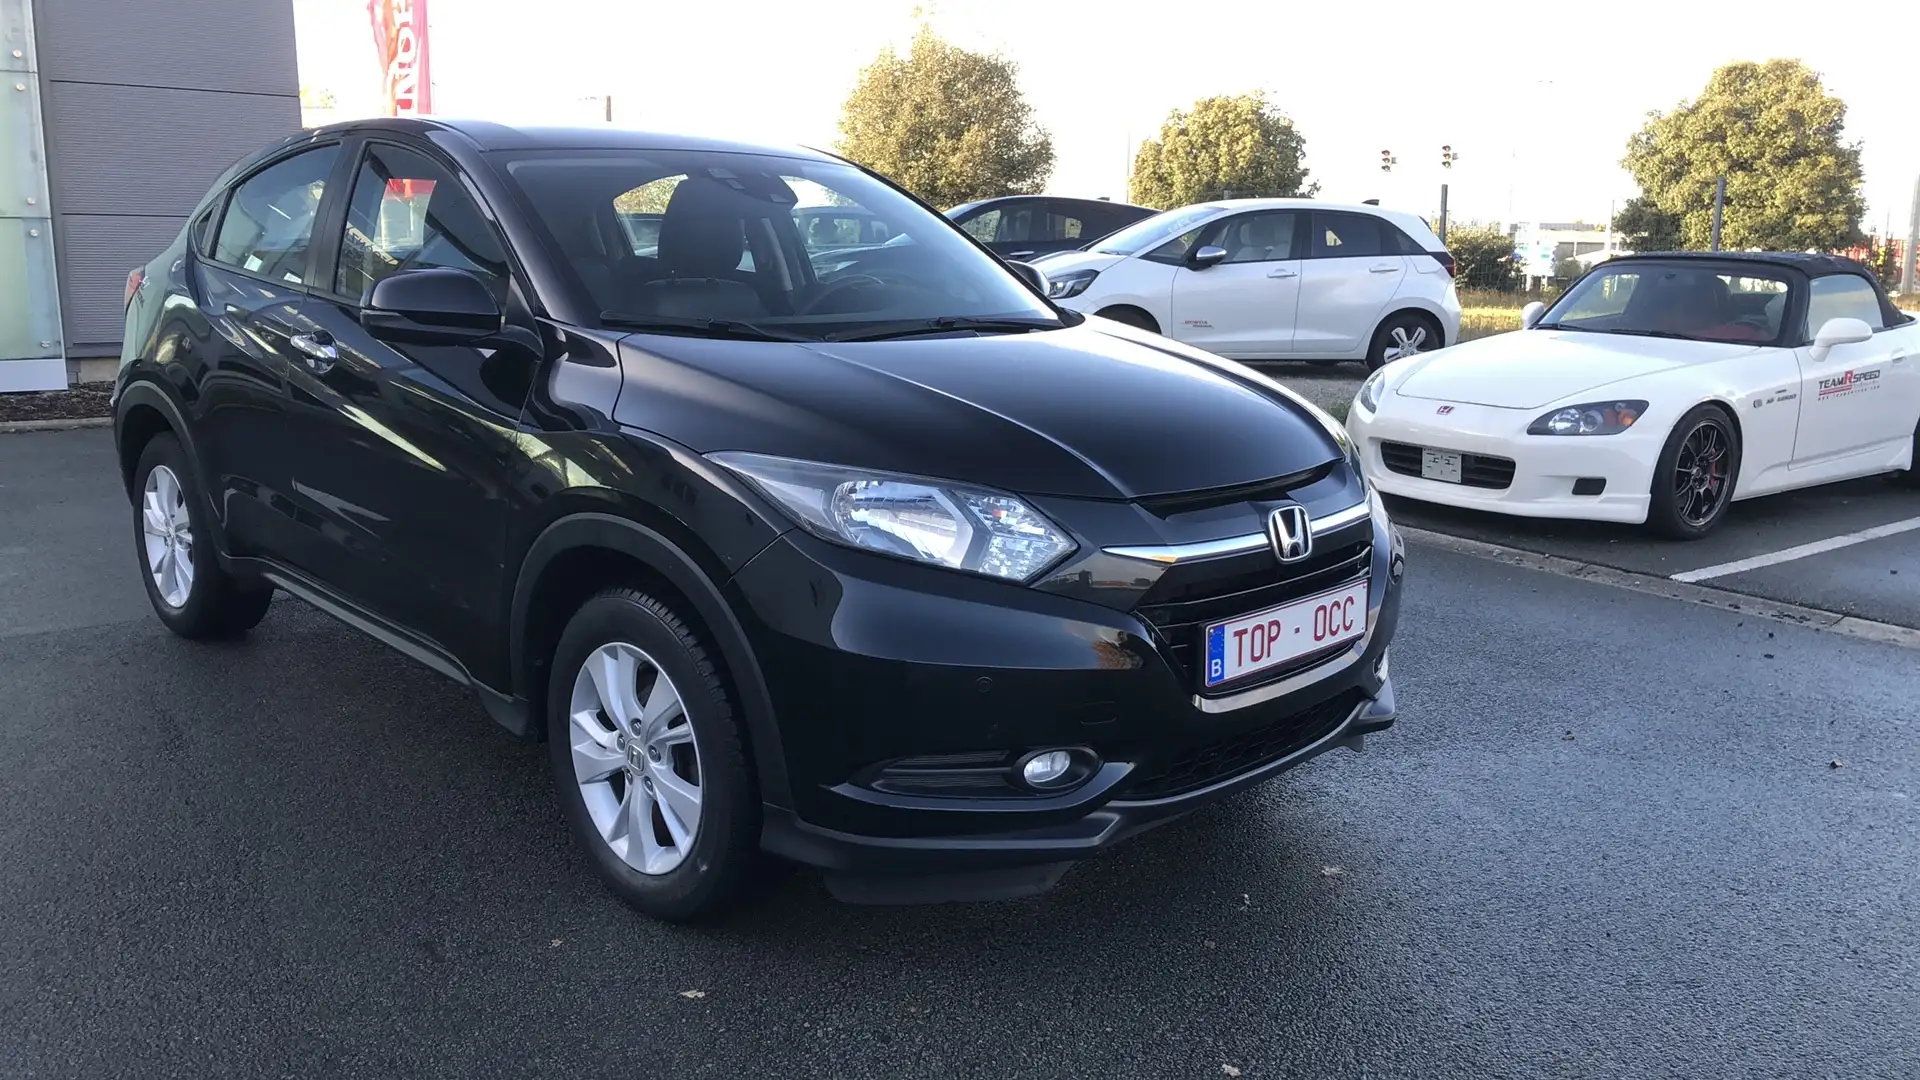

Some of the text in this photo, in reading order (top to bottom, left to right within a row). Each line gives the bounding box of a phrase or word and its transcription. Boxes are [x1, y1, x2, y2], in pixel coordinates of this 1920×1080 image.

[1233, 619, 1281, 668] TOP
[1313, 595, 1355, 642] OCC
[1211, 658, 1222, 678] B
